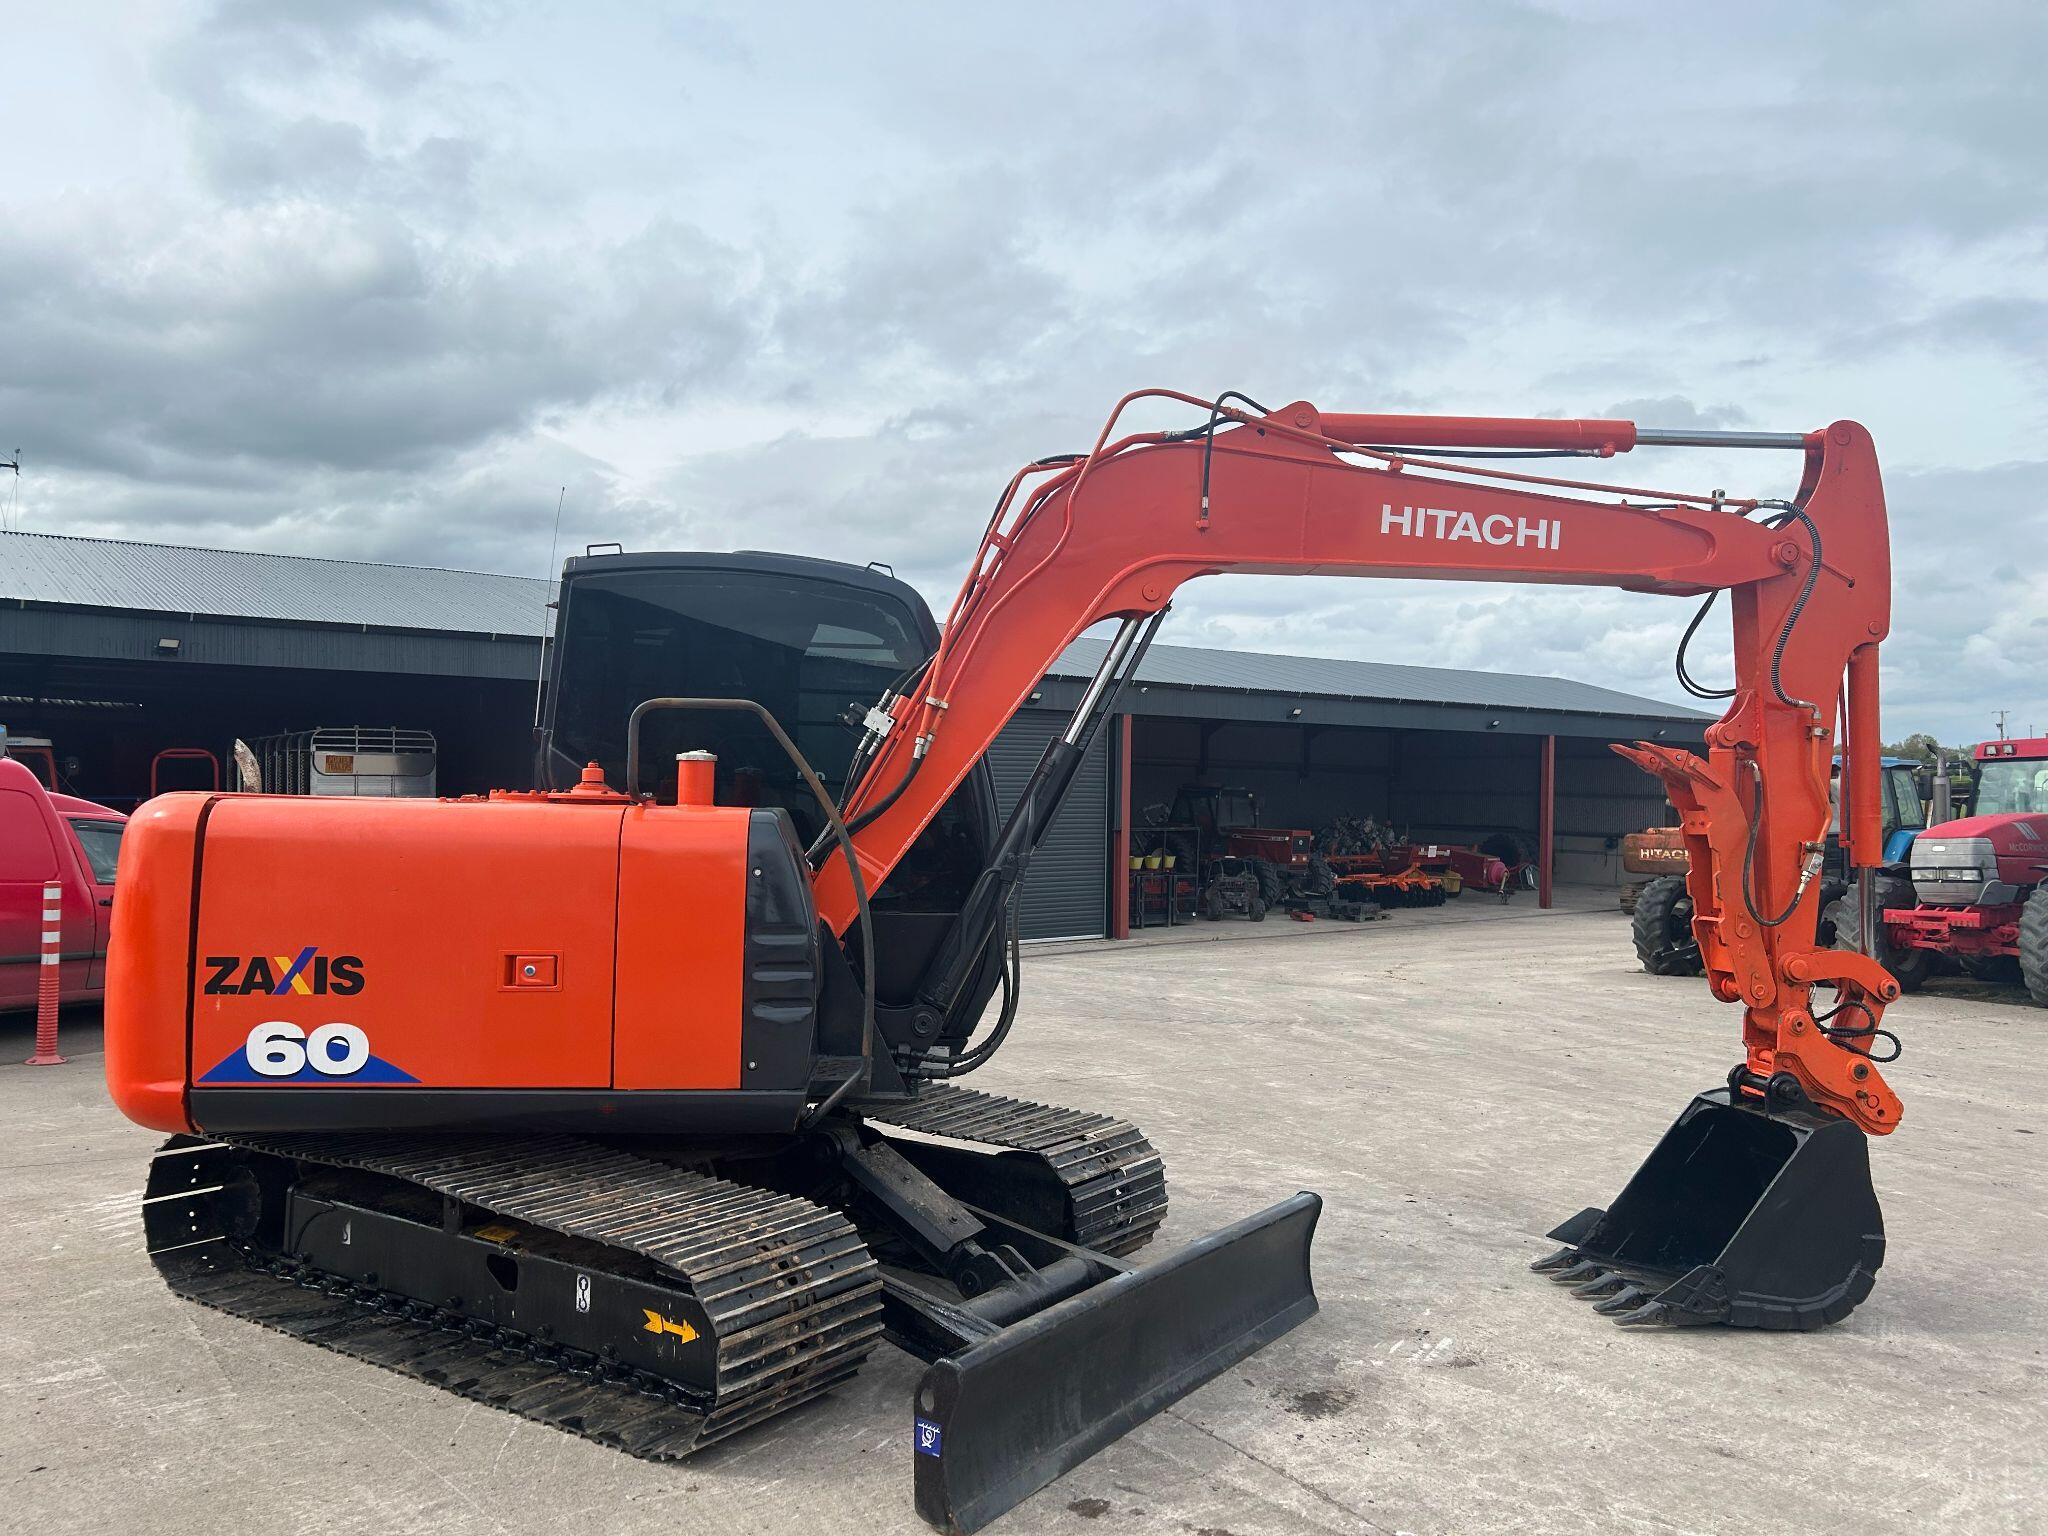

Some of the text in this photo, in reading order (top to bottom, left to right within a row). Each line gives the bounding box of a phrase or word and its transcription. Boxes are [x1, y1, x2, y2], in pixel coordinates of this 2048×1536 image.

[1380, 503, 1561, 550] HITACHI
[203, 946, 366, 996] ZAXIS
[245, 1021, 370, 1077] 60
